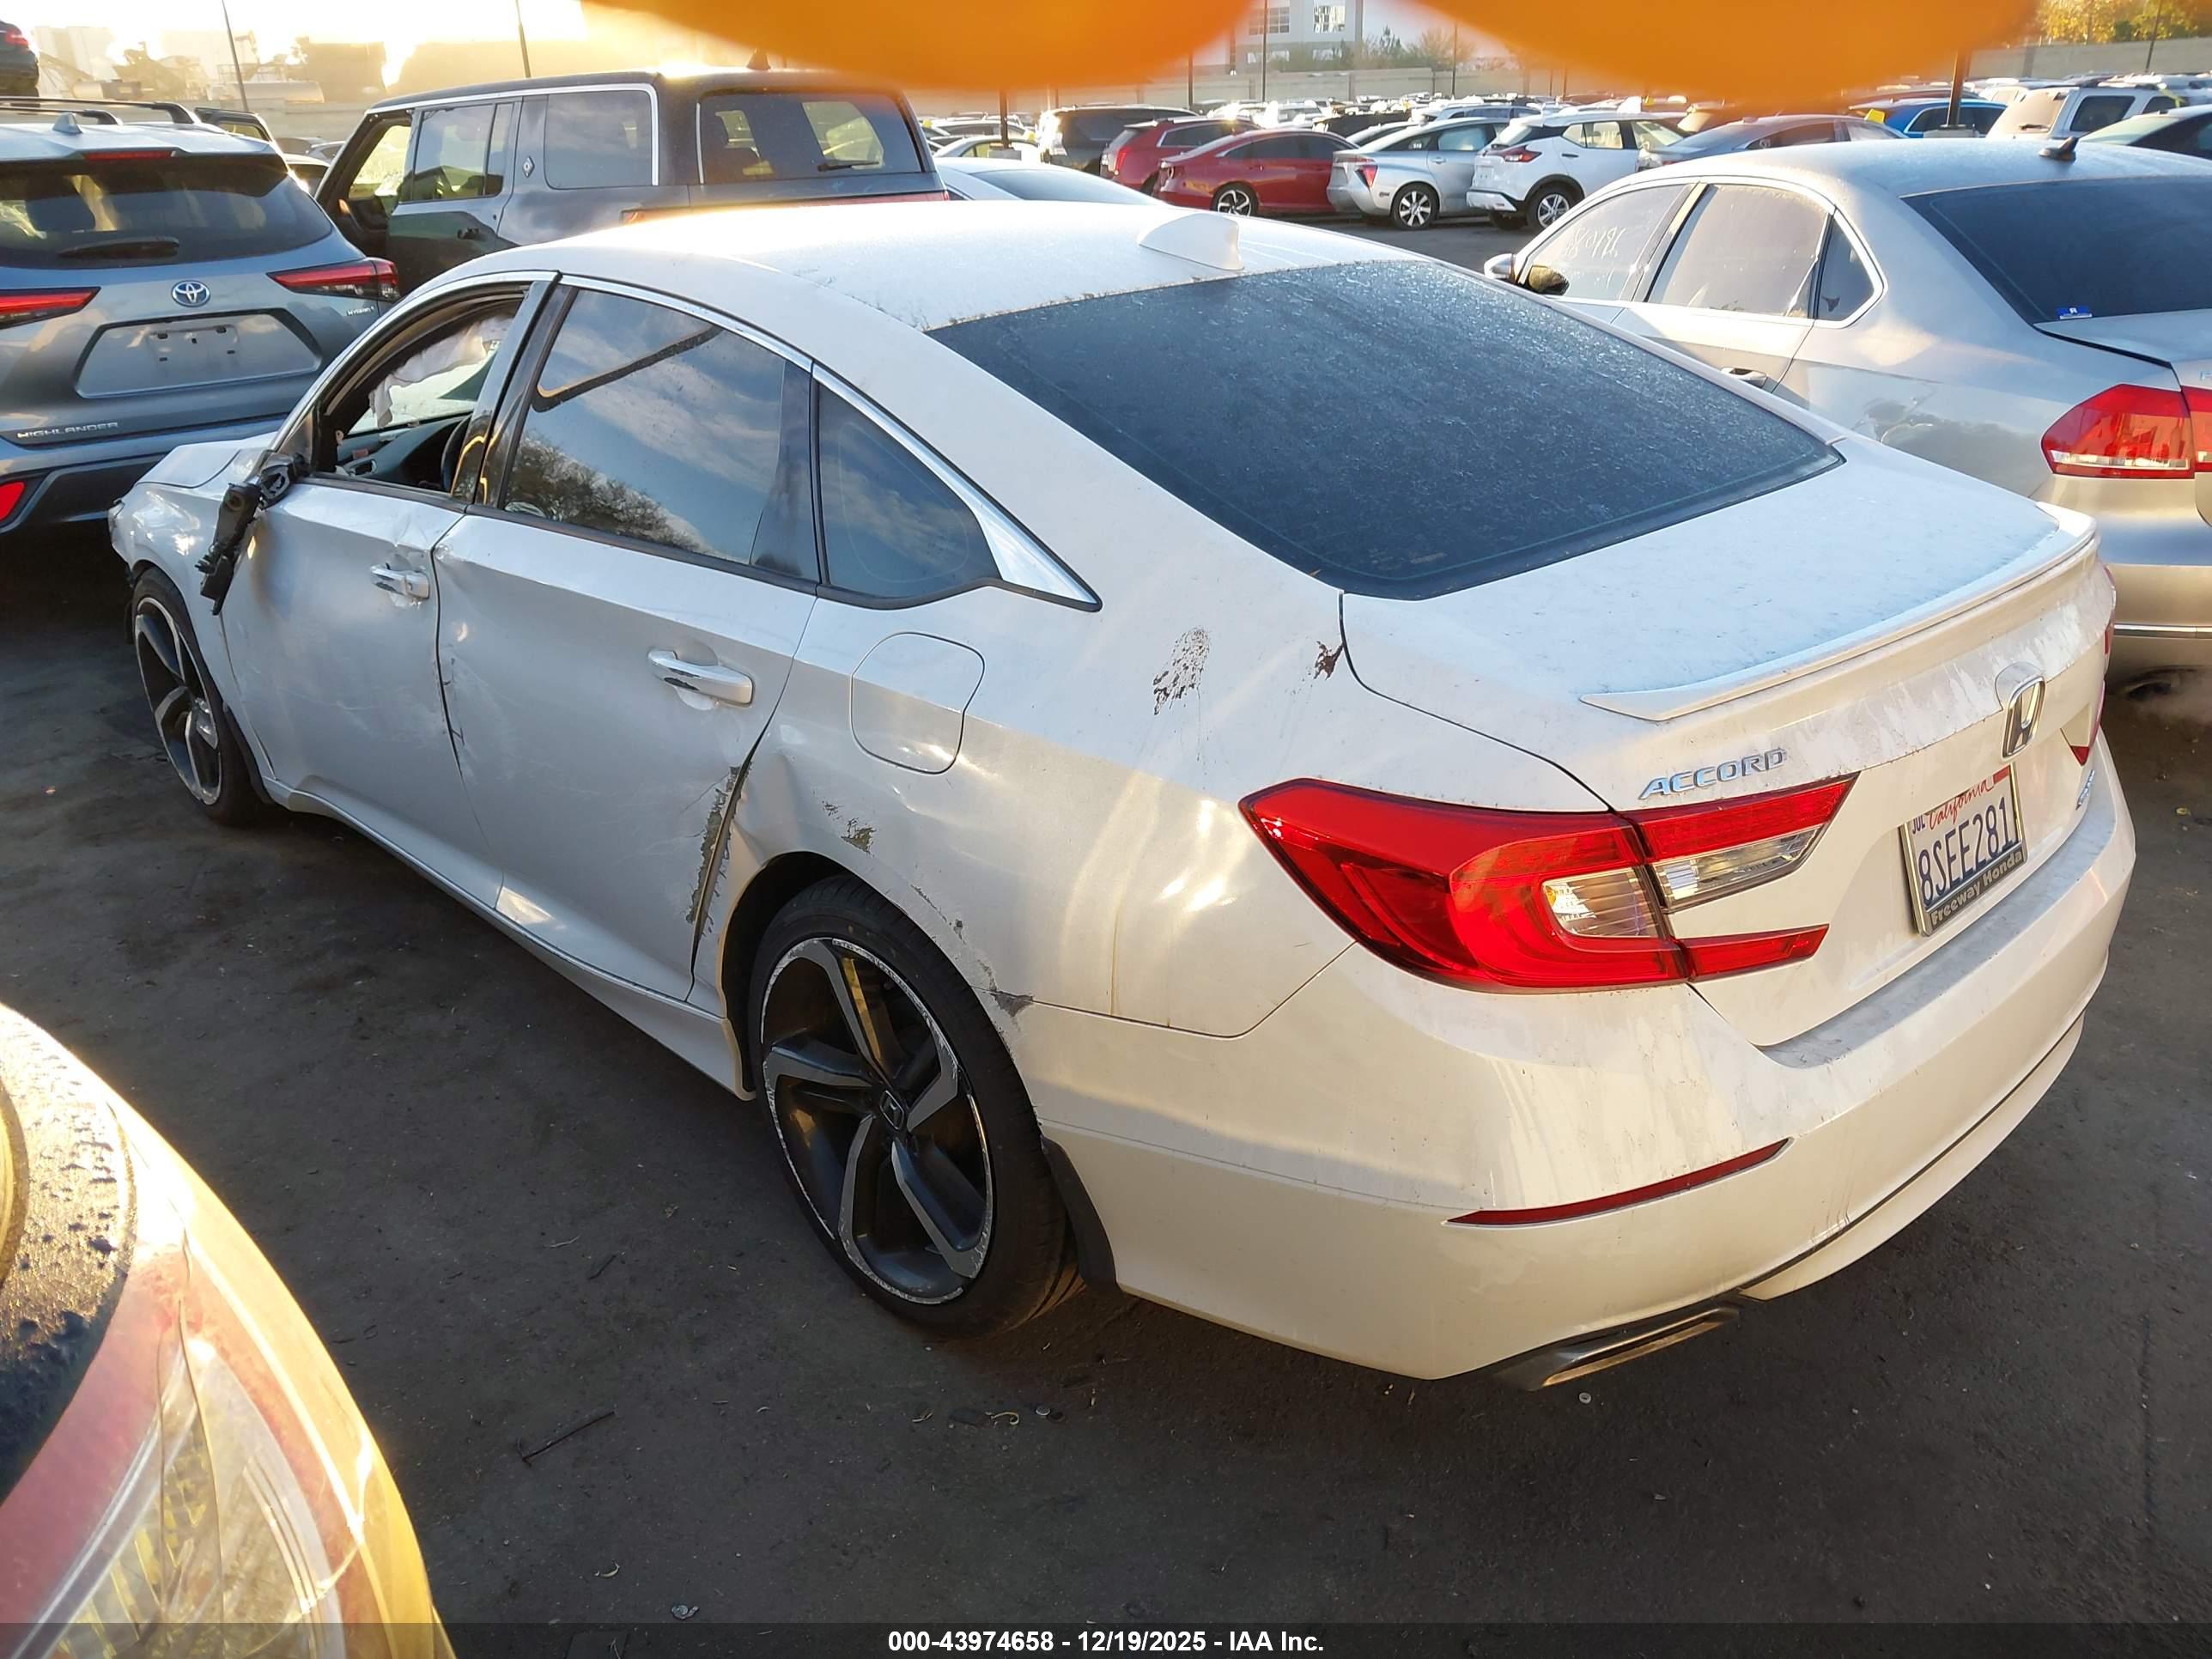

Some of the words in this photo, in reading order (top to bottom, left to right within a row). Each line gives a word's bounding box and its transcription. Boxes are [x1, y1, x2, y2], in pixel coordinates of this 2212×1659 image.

[17, 422, 118, 439] HIGHLANDER
[1638, 747, 1787, 800] ACCORD
[1929, 778, 1995, 830] California
[1918, 796, 2014, 908] 8SEE281
[1932, 881, 1982, 926] Freeway
[1982, 850, 2023, 887] Honda
